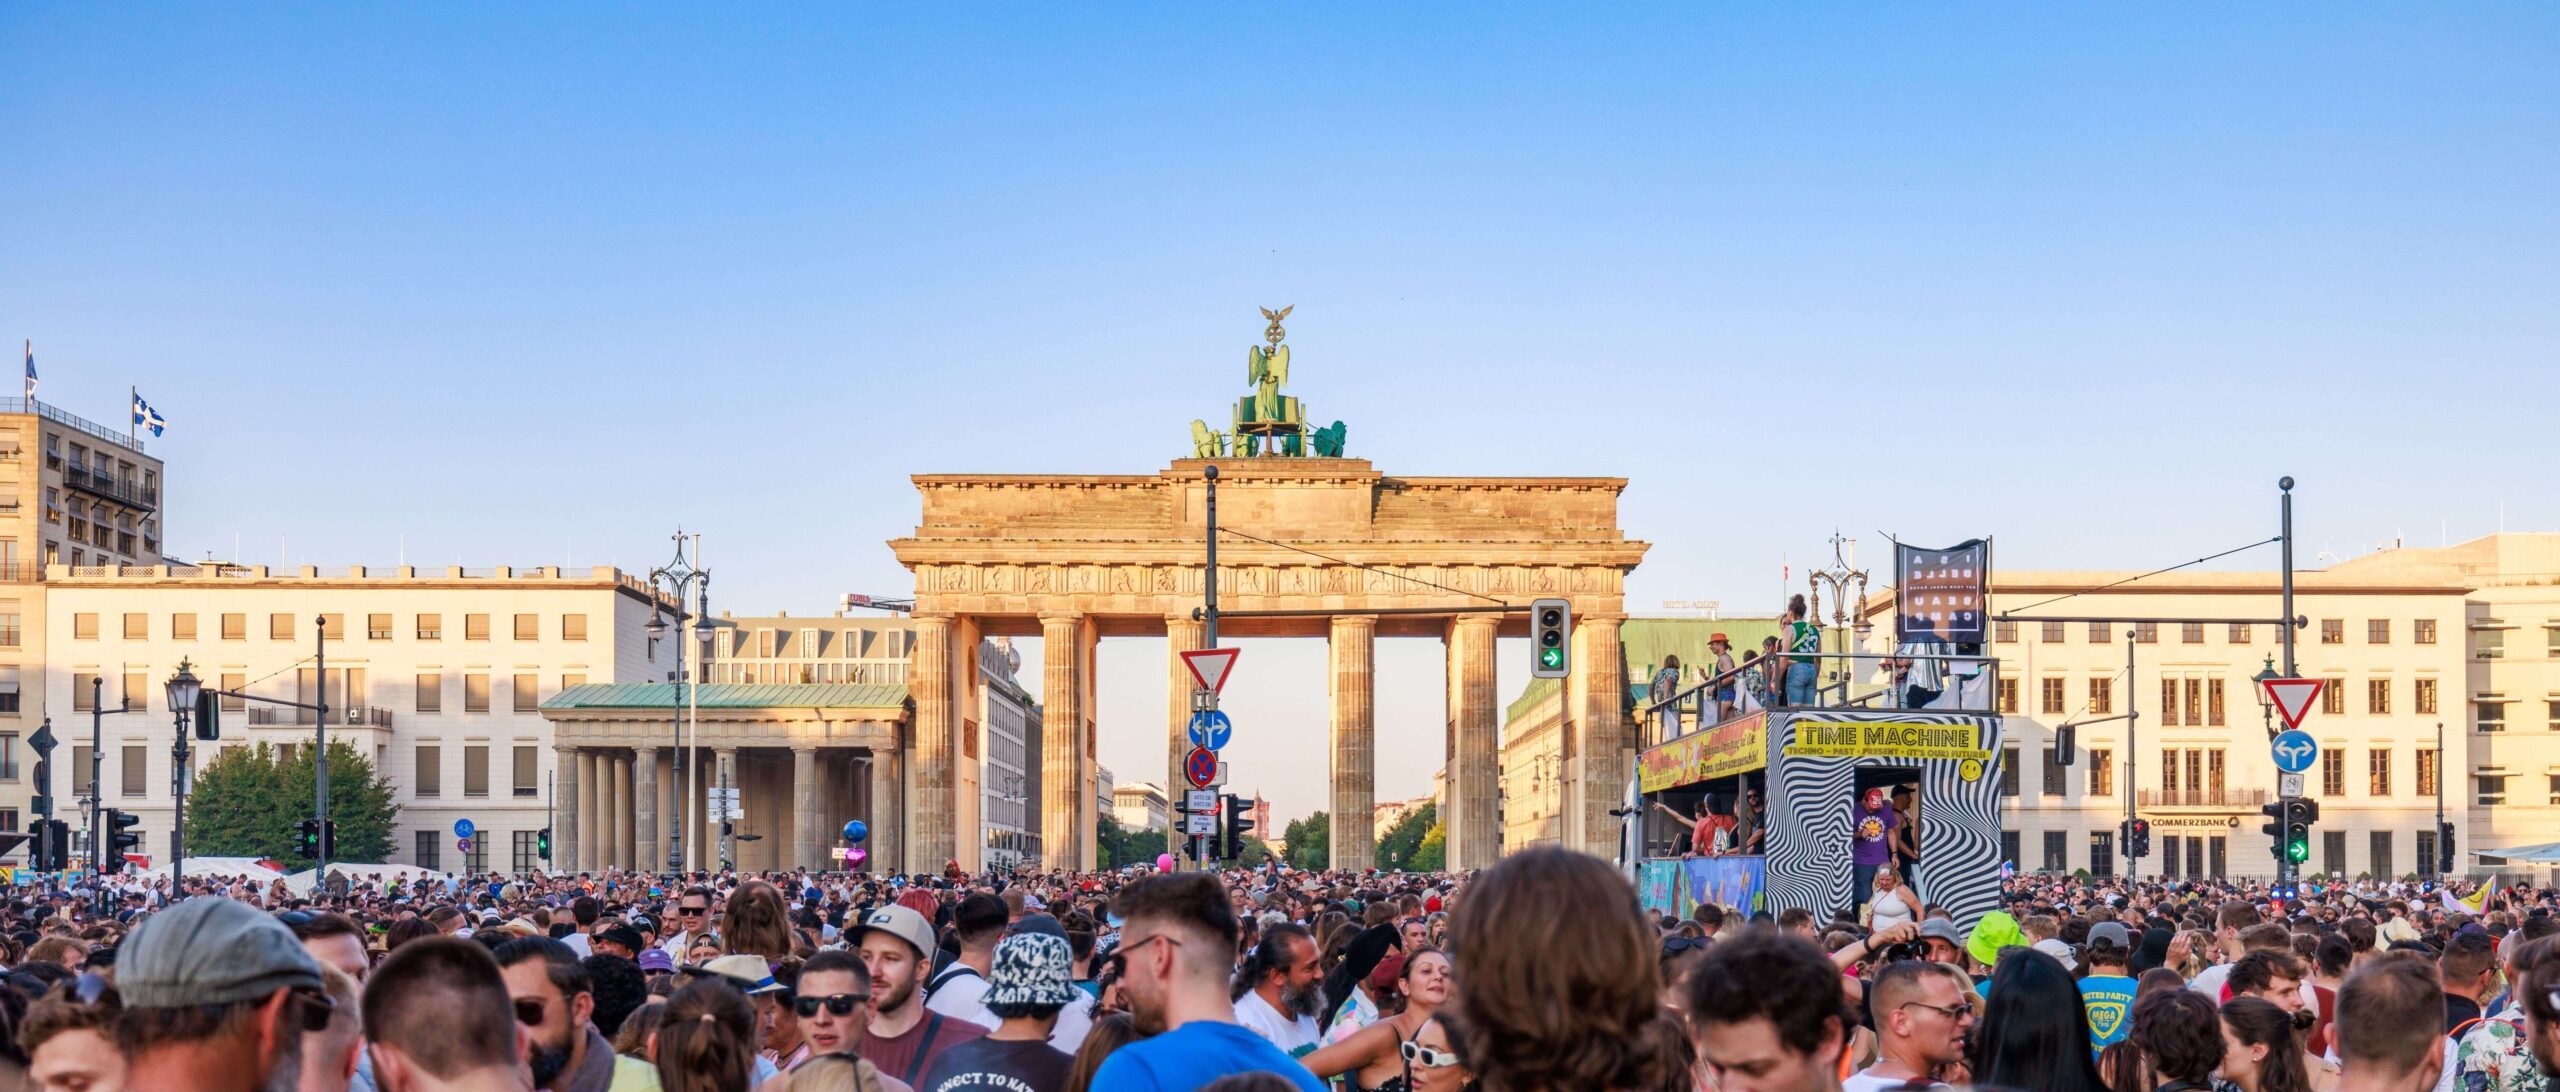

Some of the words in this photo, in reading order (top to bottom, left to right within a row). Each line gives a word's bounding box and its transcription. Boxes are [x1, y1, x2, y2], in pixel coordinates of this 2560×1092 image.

[1802, 727, 1857, 745] TIME
[1864, 727, 1970, 748] MACHINE
[1788, 747, 1824, 755] TECHNO
[1832, 747, 1855, 755] PAST
[1863, 748, 1899, 756] PRESENT
[2151, 818, 2226, 827] COMMERZBANK
[2105, 991, 2133, 1003] PARTY
[2092, 1010, 2116, 1021] MEGA
[986, 1073, 1006, 1086] TO
